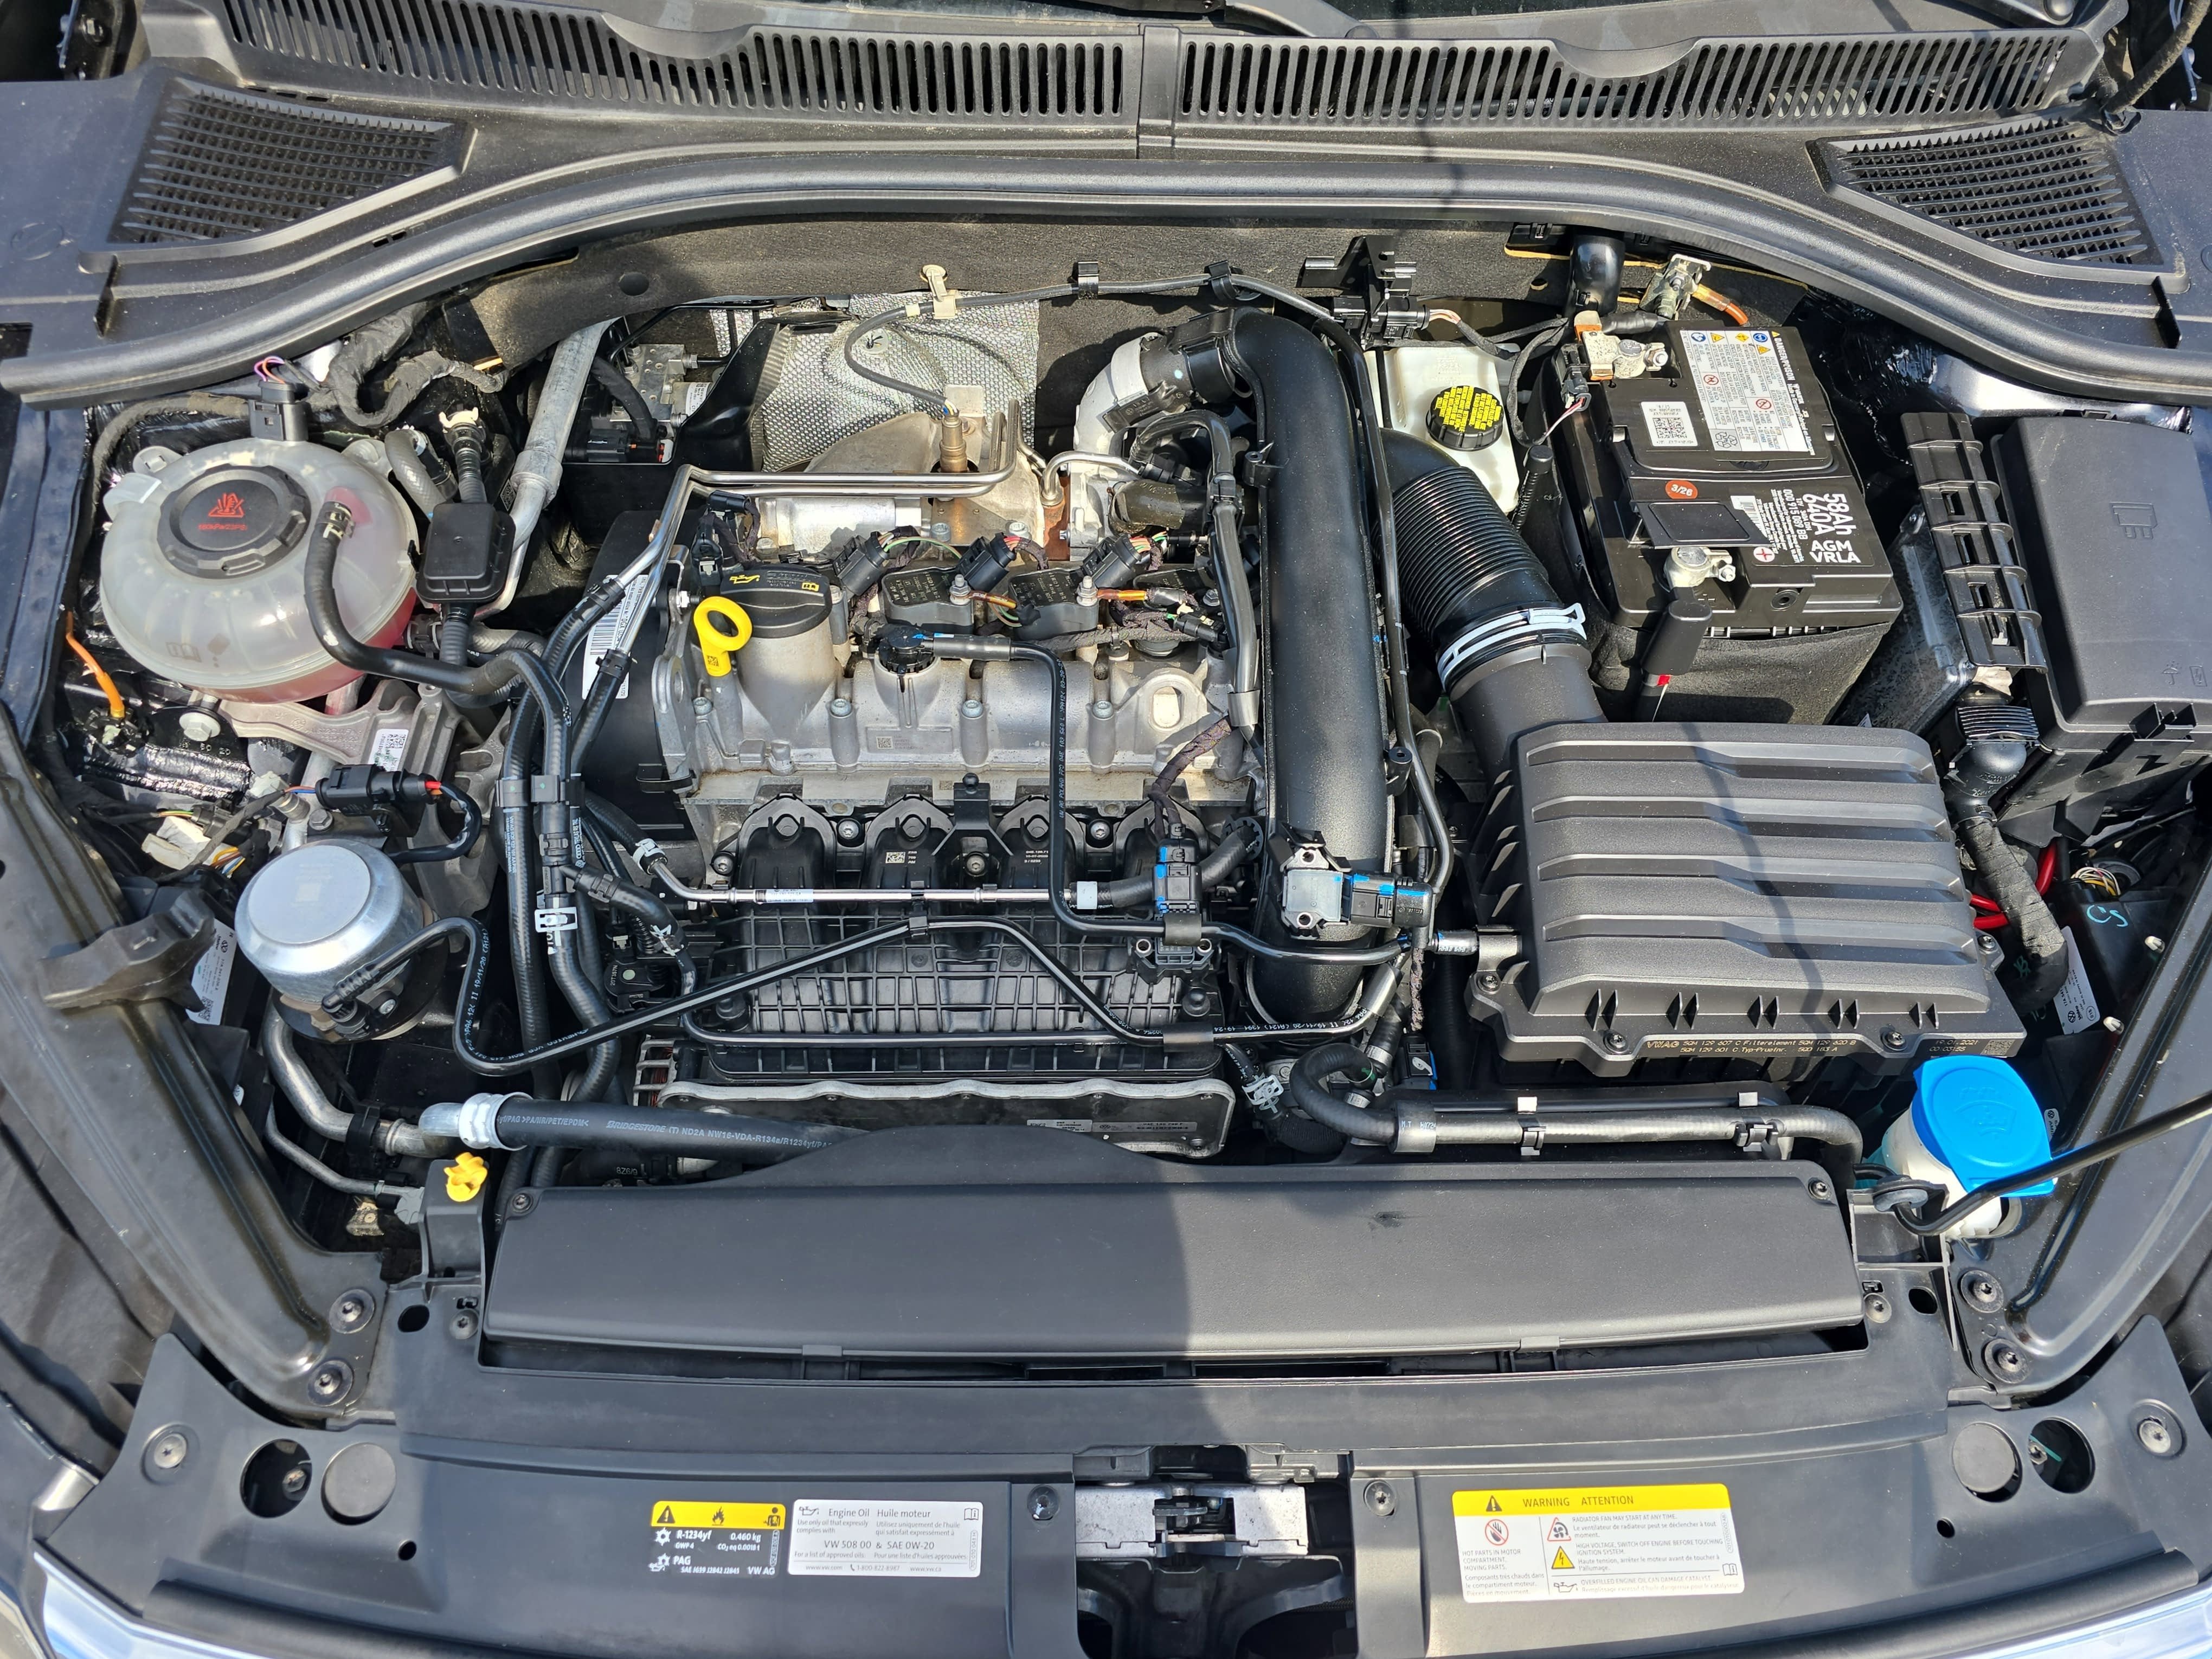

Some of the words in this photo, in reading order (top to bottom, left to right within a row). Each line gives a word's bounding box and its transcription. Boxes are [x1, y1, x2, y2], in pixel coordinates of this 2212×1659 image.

[1671, 484, 1693, 497] 3/26
[1783, 489, 1795, 501] 000
[1787, 502, 1799, 515] 915
[1823, 493, 1856, 535] 58Ah
[1803, 494, 1835, 535] 640A
[1791, 516, 1804, 528] 089
[1811, 540, 1853, 551] AGM
[1809, 552, 1861, 563] VRLA
[610, 965, 618, 986] 20T357N
[1292, 1021, 1326, 1030] 19/11/20
[607, 1120, 666, 1133] BRIDGESTONE
[668, 1127, 679, 1135] (T)
[682, 1128, 705, 1137] ND2A
[1522, 1497, 1570, 1508] WARNING
[1581, 1496, 1634, 1506] ATTENTION
[829, 1508, 856, 1519] Engine
[858, 1508, 870, 1517] Oil
[877, 1509, 898, 1517] Huile
[898, 1521, 933, 1529] uniquement
[1581, 1523, 1612, 1531] ventilateur
[676, 1529, 712, 1542] R-1234yf
[730, 1533, 751, 1541] 0.460
[752, 1533, 762, 1543] kg
[824, 1540, 840, 1548] VW
[886, 1541, 903, 1549] SAE
[905, 1541, 935, 1549] 0W-20
[673, 1555, 691, 1565] PAG
[747, 1566, 762, 1576] VW
[762, 1567, 775, 1576] AG
